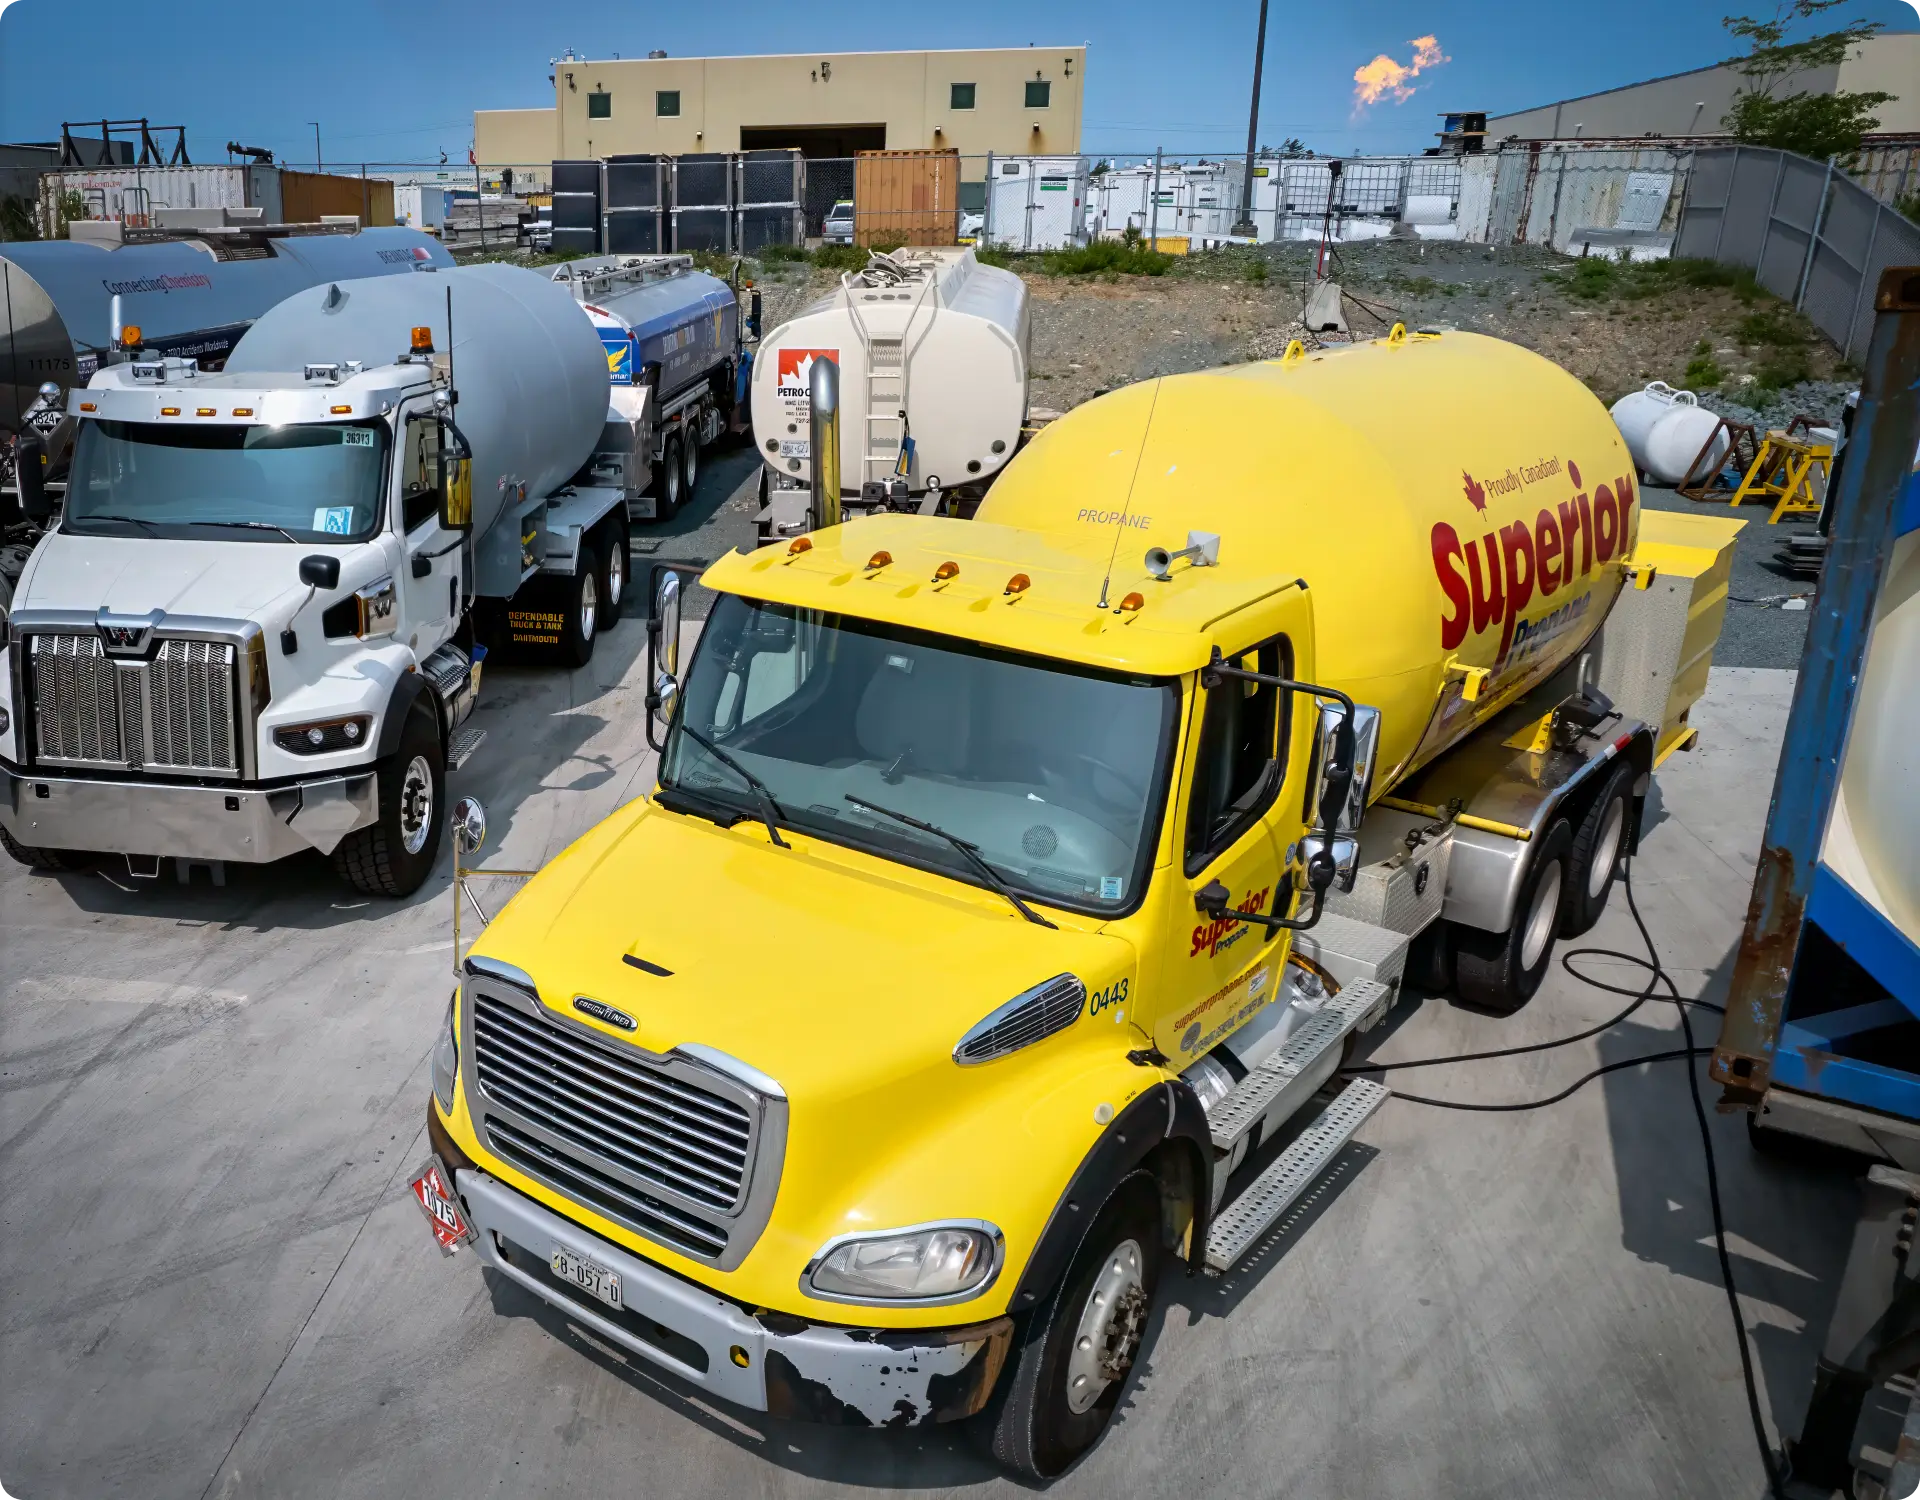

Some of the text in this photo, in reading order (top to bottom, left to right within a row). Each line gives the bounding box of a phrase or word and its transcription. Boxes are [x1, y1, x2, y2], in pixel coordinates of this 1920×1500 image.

[29, 359, 70, 370] 11175
[1485, 456, 1562, 498] Proudly Canadian!
[1077, 508, 1152, 530] PROPANE
[1431, 459, 1635, 679] Superior
[508, 611, 565, 623] DEPENDABLE
[510, 620, 534, 629] TRUCK
[544, 622, 562, 630] TANK
[513, 633, 558, 644] DARTMOUTH
[1215, 925, 1250, 955] Propane
[1090, 977, 1129, 1017] 0443
[1173, 960, 1263, 1033] superiorpropane.com
[578, 999, 631, 1027] FREIGHTLINER
[423, 1184, 456, 1228] 1075
